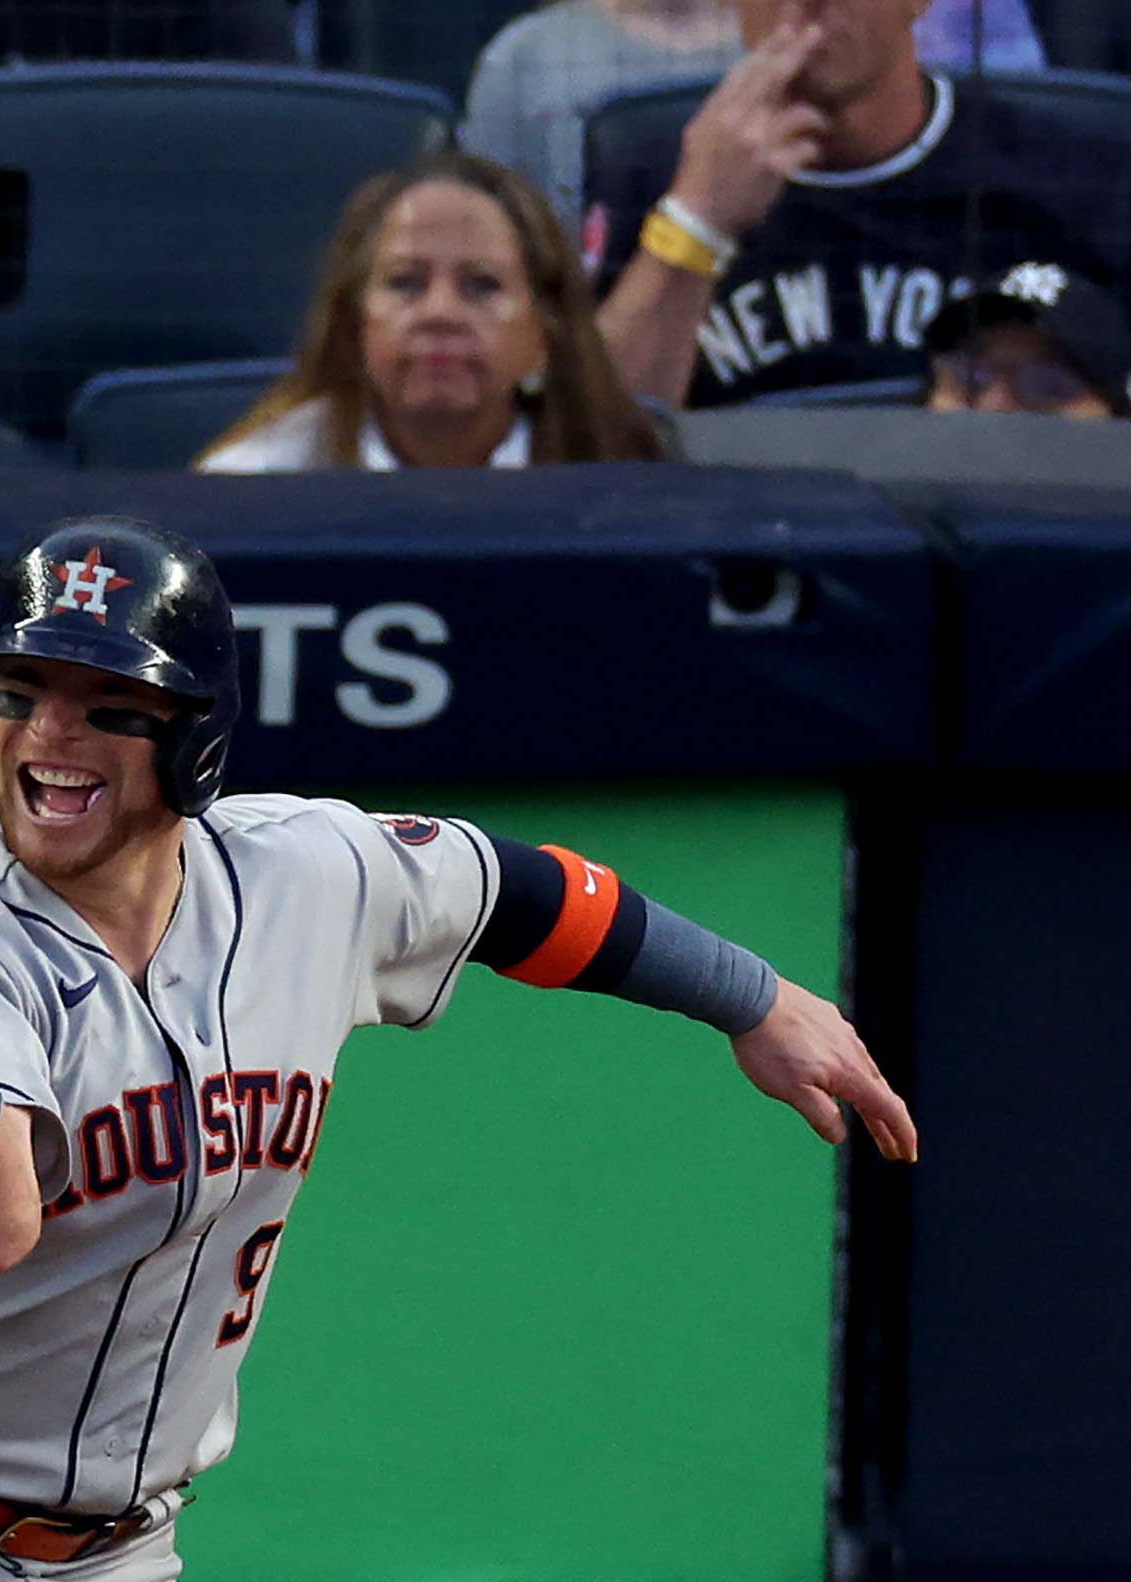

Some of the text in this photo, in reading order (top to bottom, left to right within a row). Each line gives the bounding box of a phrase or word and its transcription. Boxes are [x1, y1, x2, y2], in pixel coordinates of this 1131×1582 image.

[697, 265, 832, 385] NEW
[860, 266, 973, 347] YO
[54, 560, 115, 615] H
[42, 1070, 334, 1220] OUSTO
[215, 1220, 284, 1350] 9
